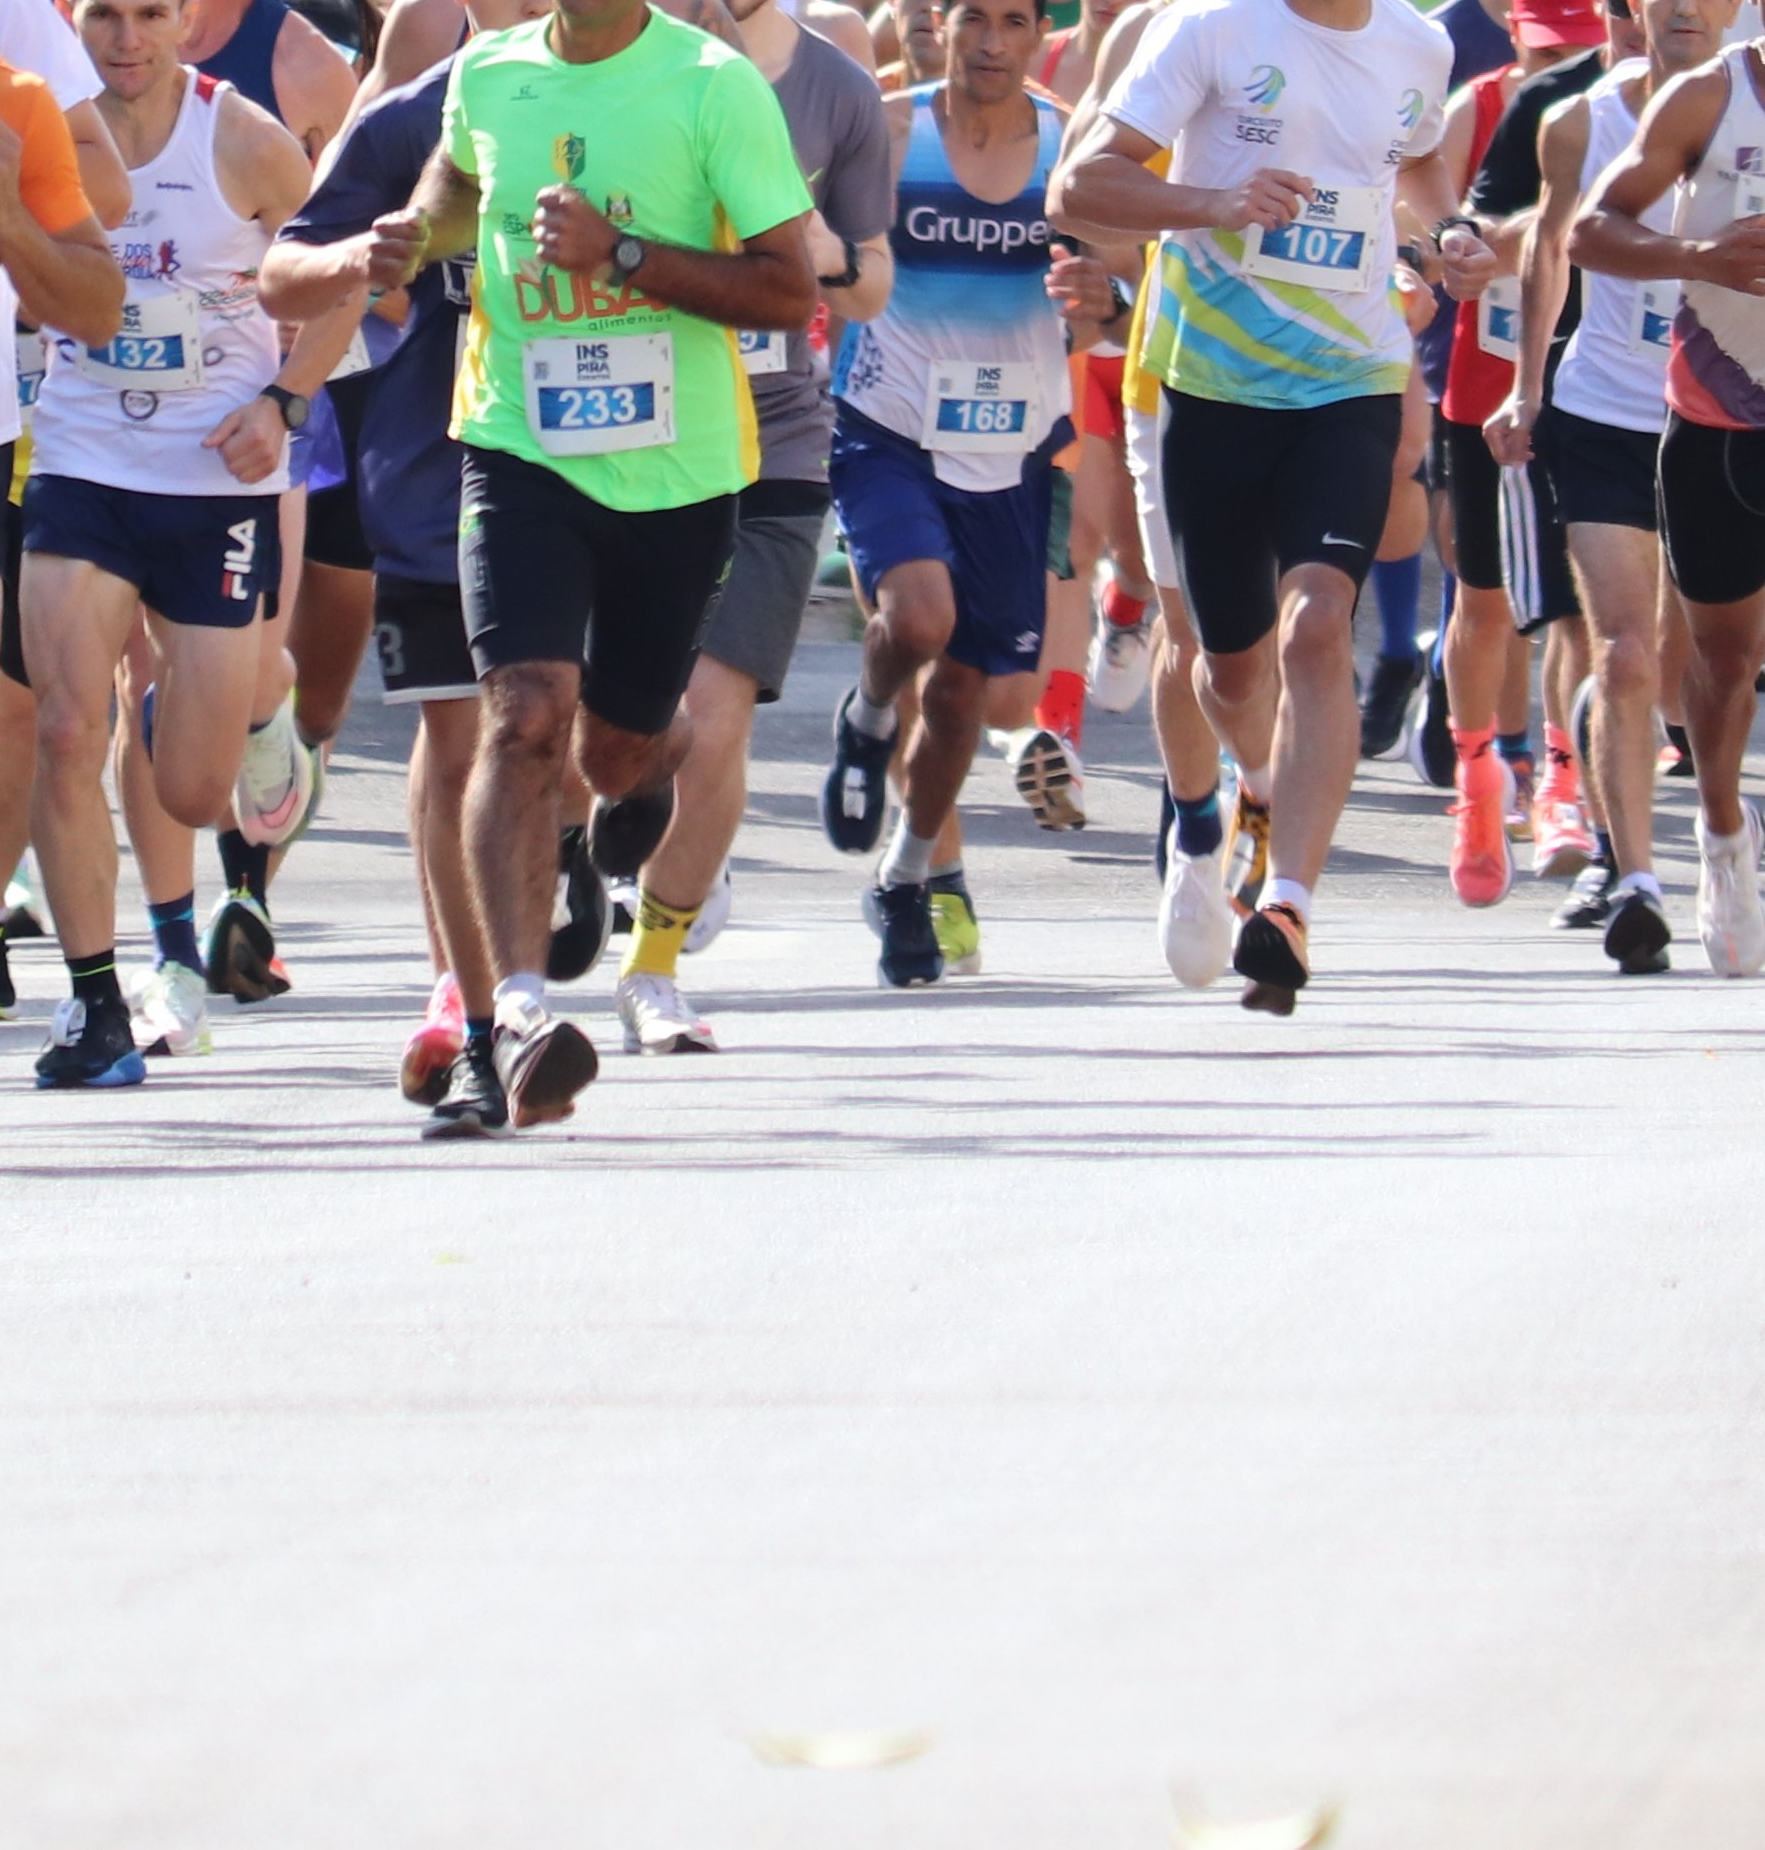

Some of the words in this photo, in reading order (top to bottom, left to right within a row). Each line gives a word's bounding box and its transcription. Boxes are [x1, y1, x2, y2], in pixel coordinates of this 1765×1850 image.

[1236, 125, 1280, 145] SESC
[906, 206, 1050, 254] Gruppe
[1284, 226, 1353, 265] 107
[587, 312, 673, 332] alimentos
[576, 344, 609, 361] INS
[577, 361, 610, 374] PIRA
[977, 367, 1002, 381] INS
[558, 387, 637, 428] 233
[956, 401, 1013, 432] 168
[220, 518, 257, 601] FILA
